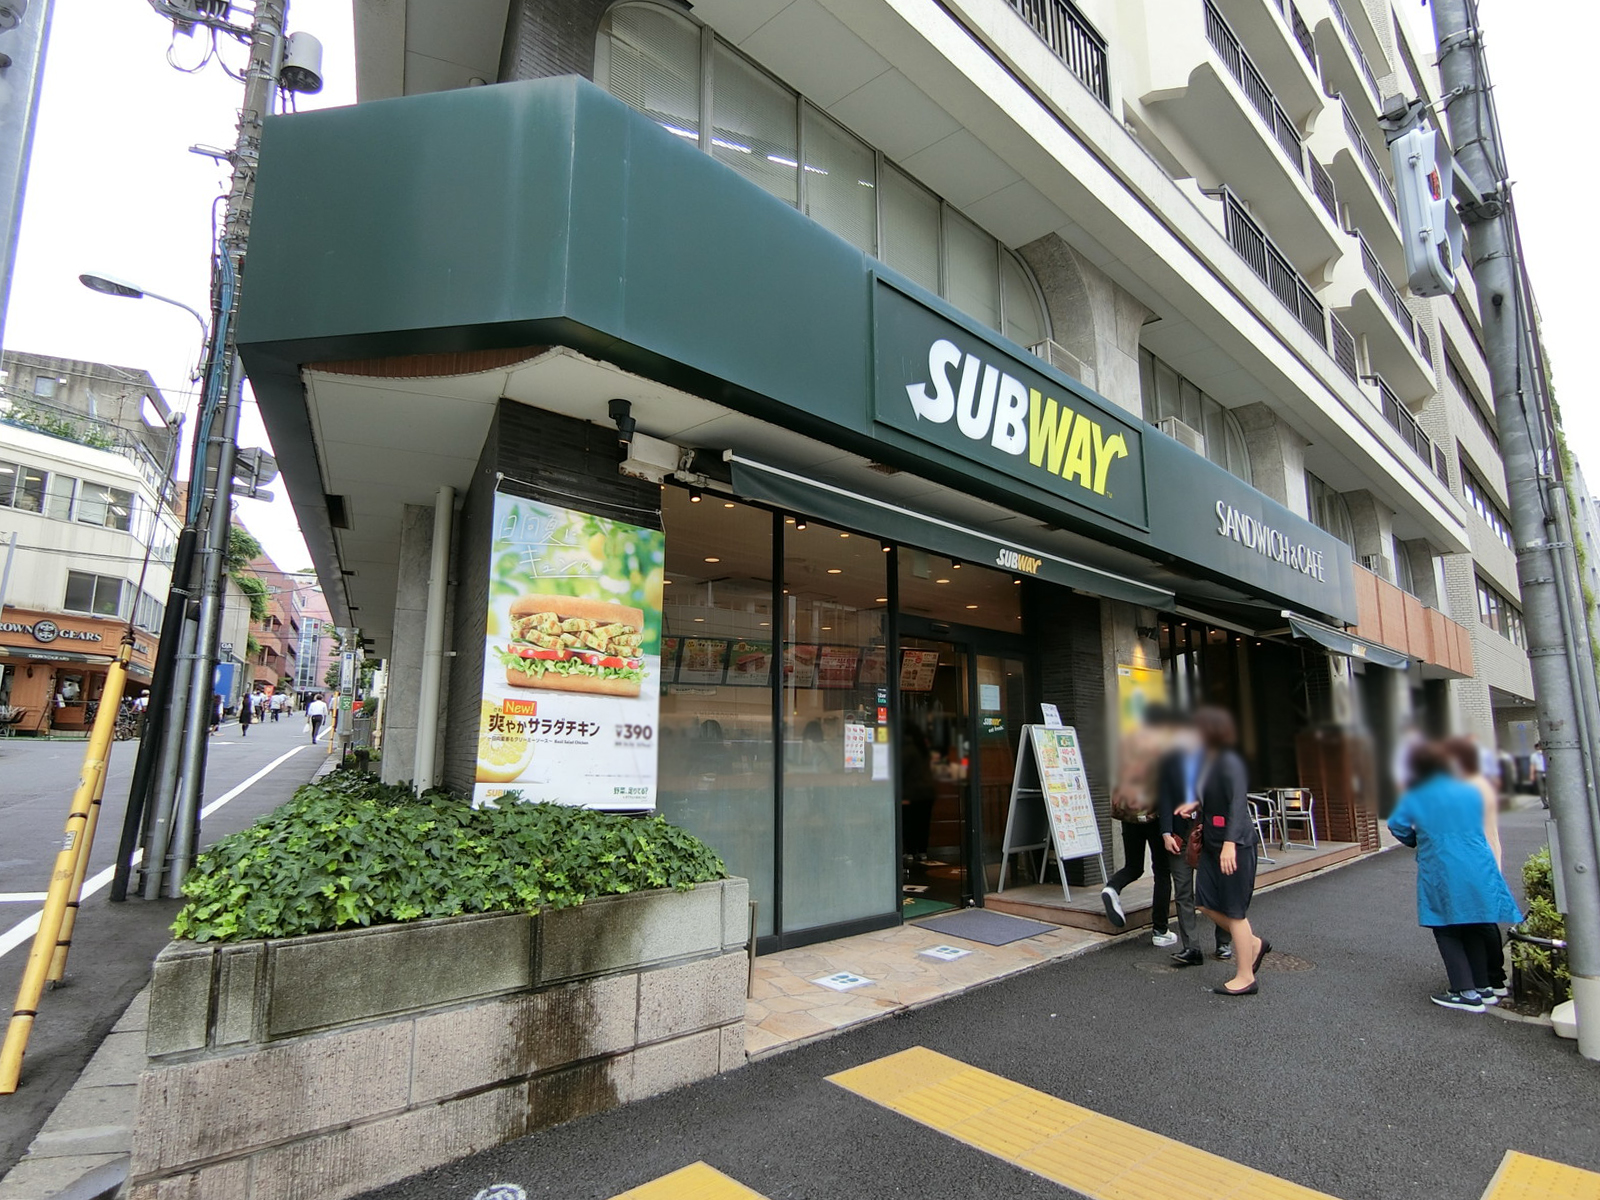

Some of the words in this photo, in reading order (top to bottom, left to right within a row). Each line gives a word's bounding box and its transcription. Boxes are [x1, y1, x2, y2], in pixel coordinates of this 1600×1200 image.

[905, 338, 1129, 496] SUBWAY
[995, 548, 1042, 575] SUBWAY
[59, 628, 103, 642] GEARS
[505, 701, 536, 715] New!
[488, 713, 601, 738] 爽やかサラダチキン
